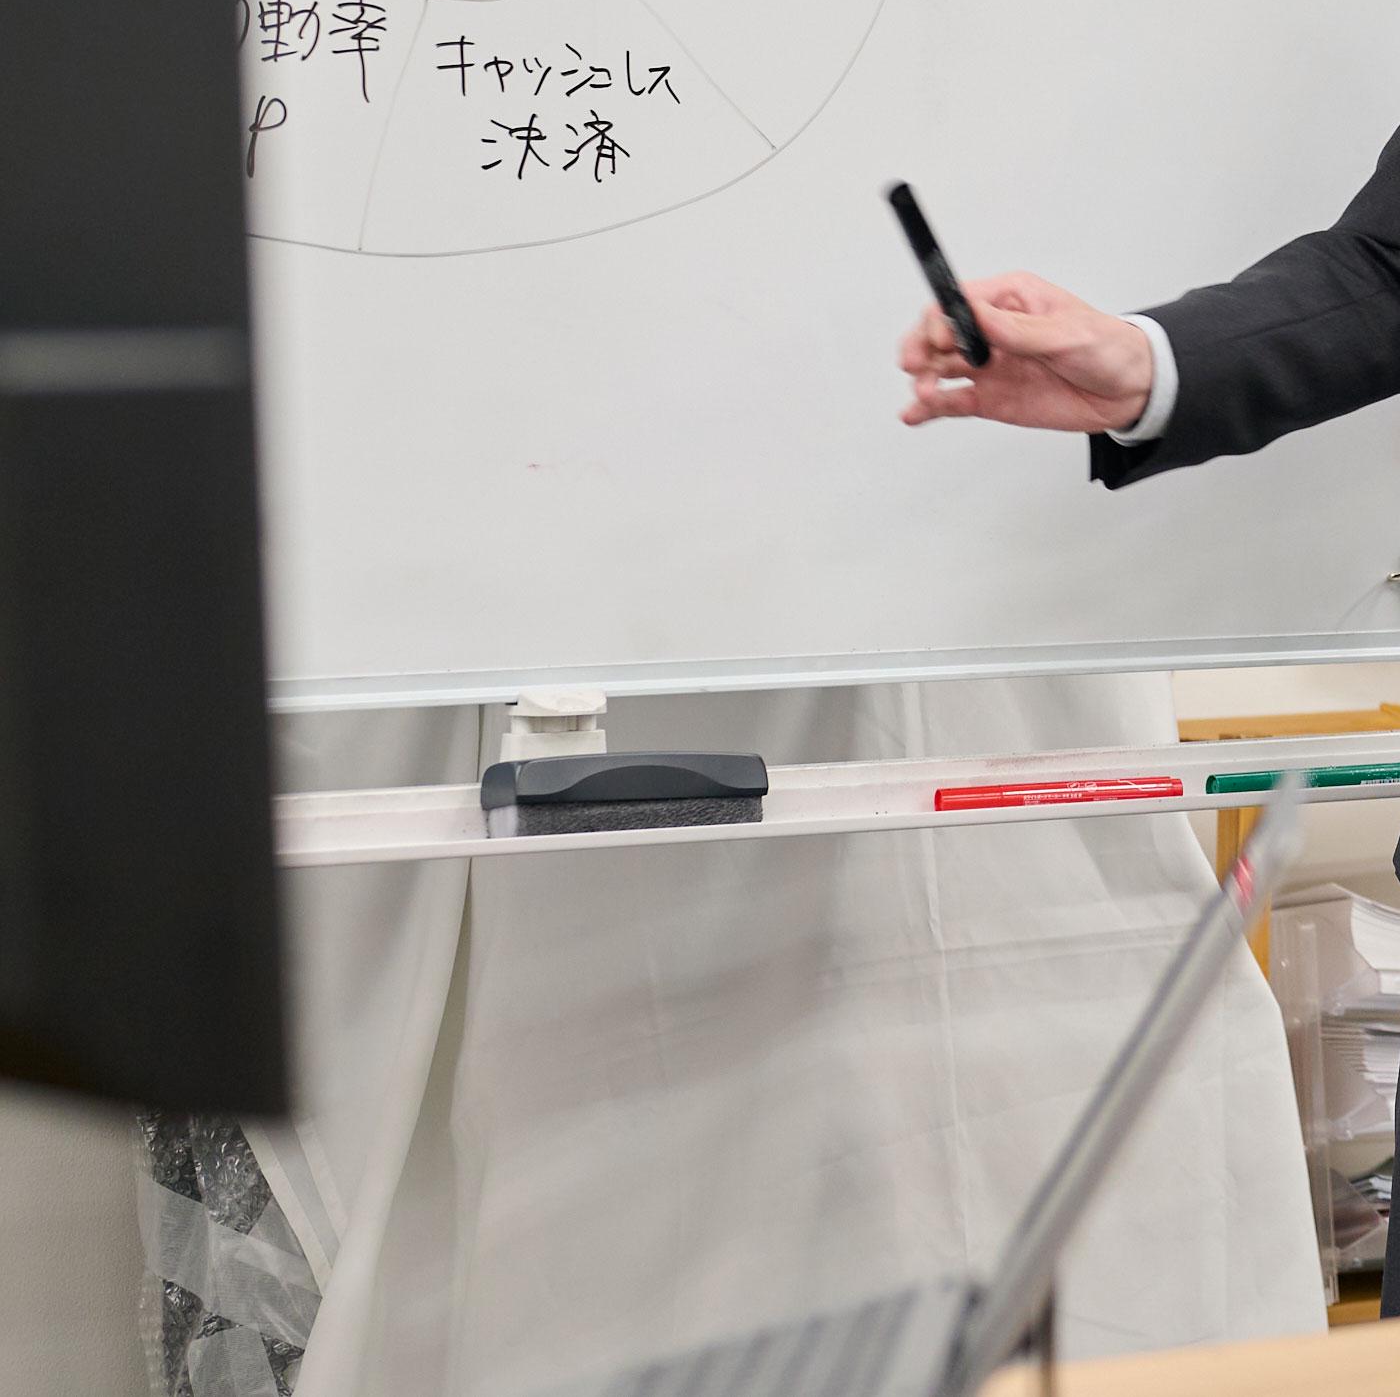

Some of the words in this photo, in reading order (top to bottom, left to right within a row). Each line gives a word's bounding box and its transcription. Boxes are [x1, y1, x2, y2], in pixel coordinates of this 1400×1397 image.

[434, 33, 682, 106] キャッシュレス
[480, 107, 632, 185] 決済
